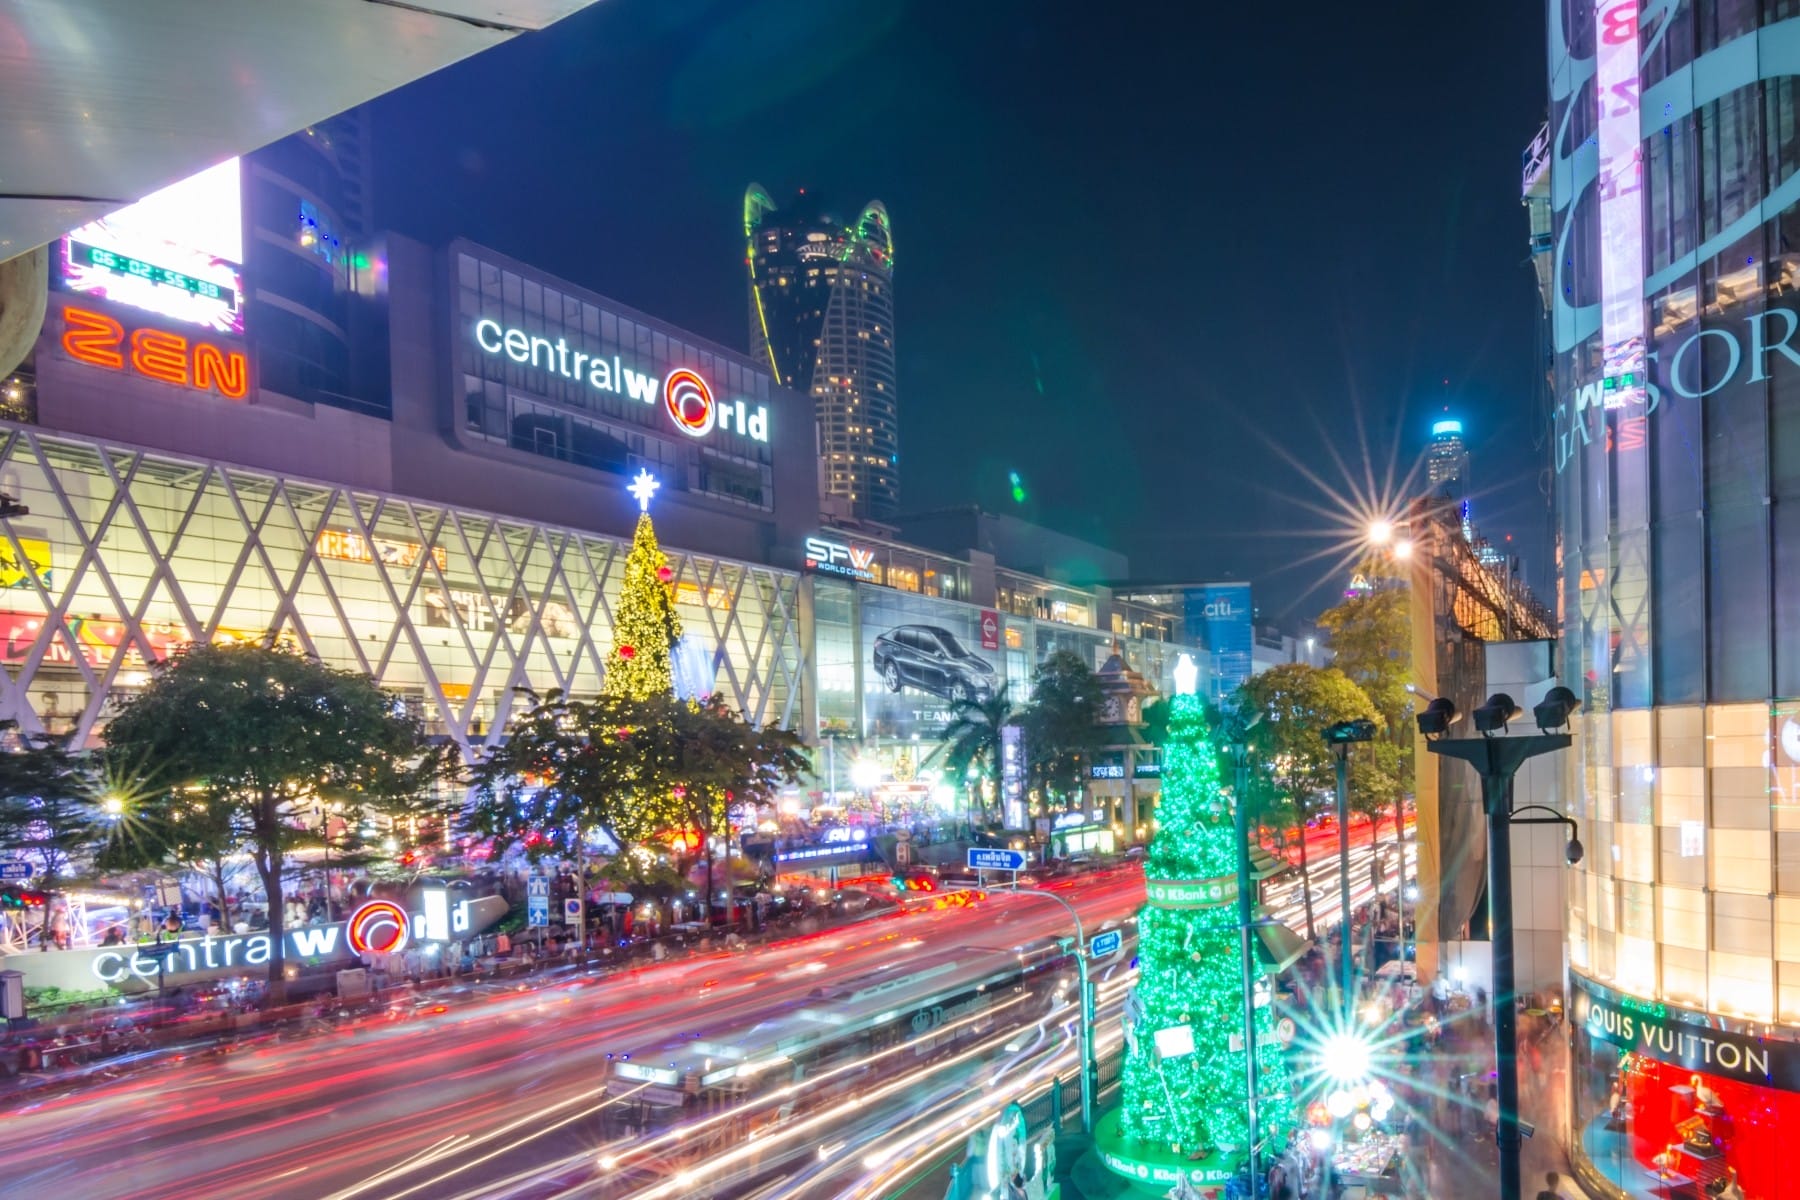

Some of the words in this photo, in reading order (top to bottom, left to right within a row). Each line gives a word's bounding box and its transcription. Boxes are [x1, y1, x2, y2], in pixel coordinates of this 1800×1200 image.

[62, 306, 249, 399] ZEN
[818, 562, 846, 573] WORLD
[912, 710, 960, 722] TEANA
[1642, 1021, 1769, 1076] VUITTON
